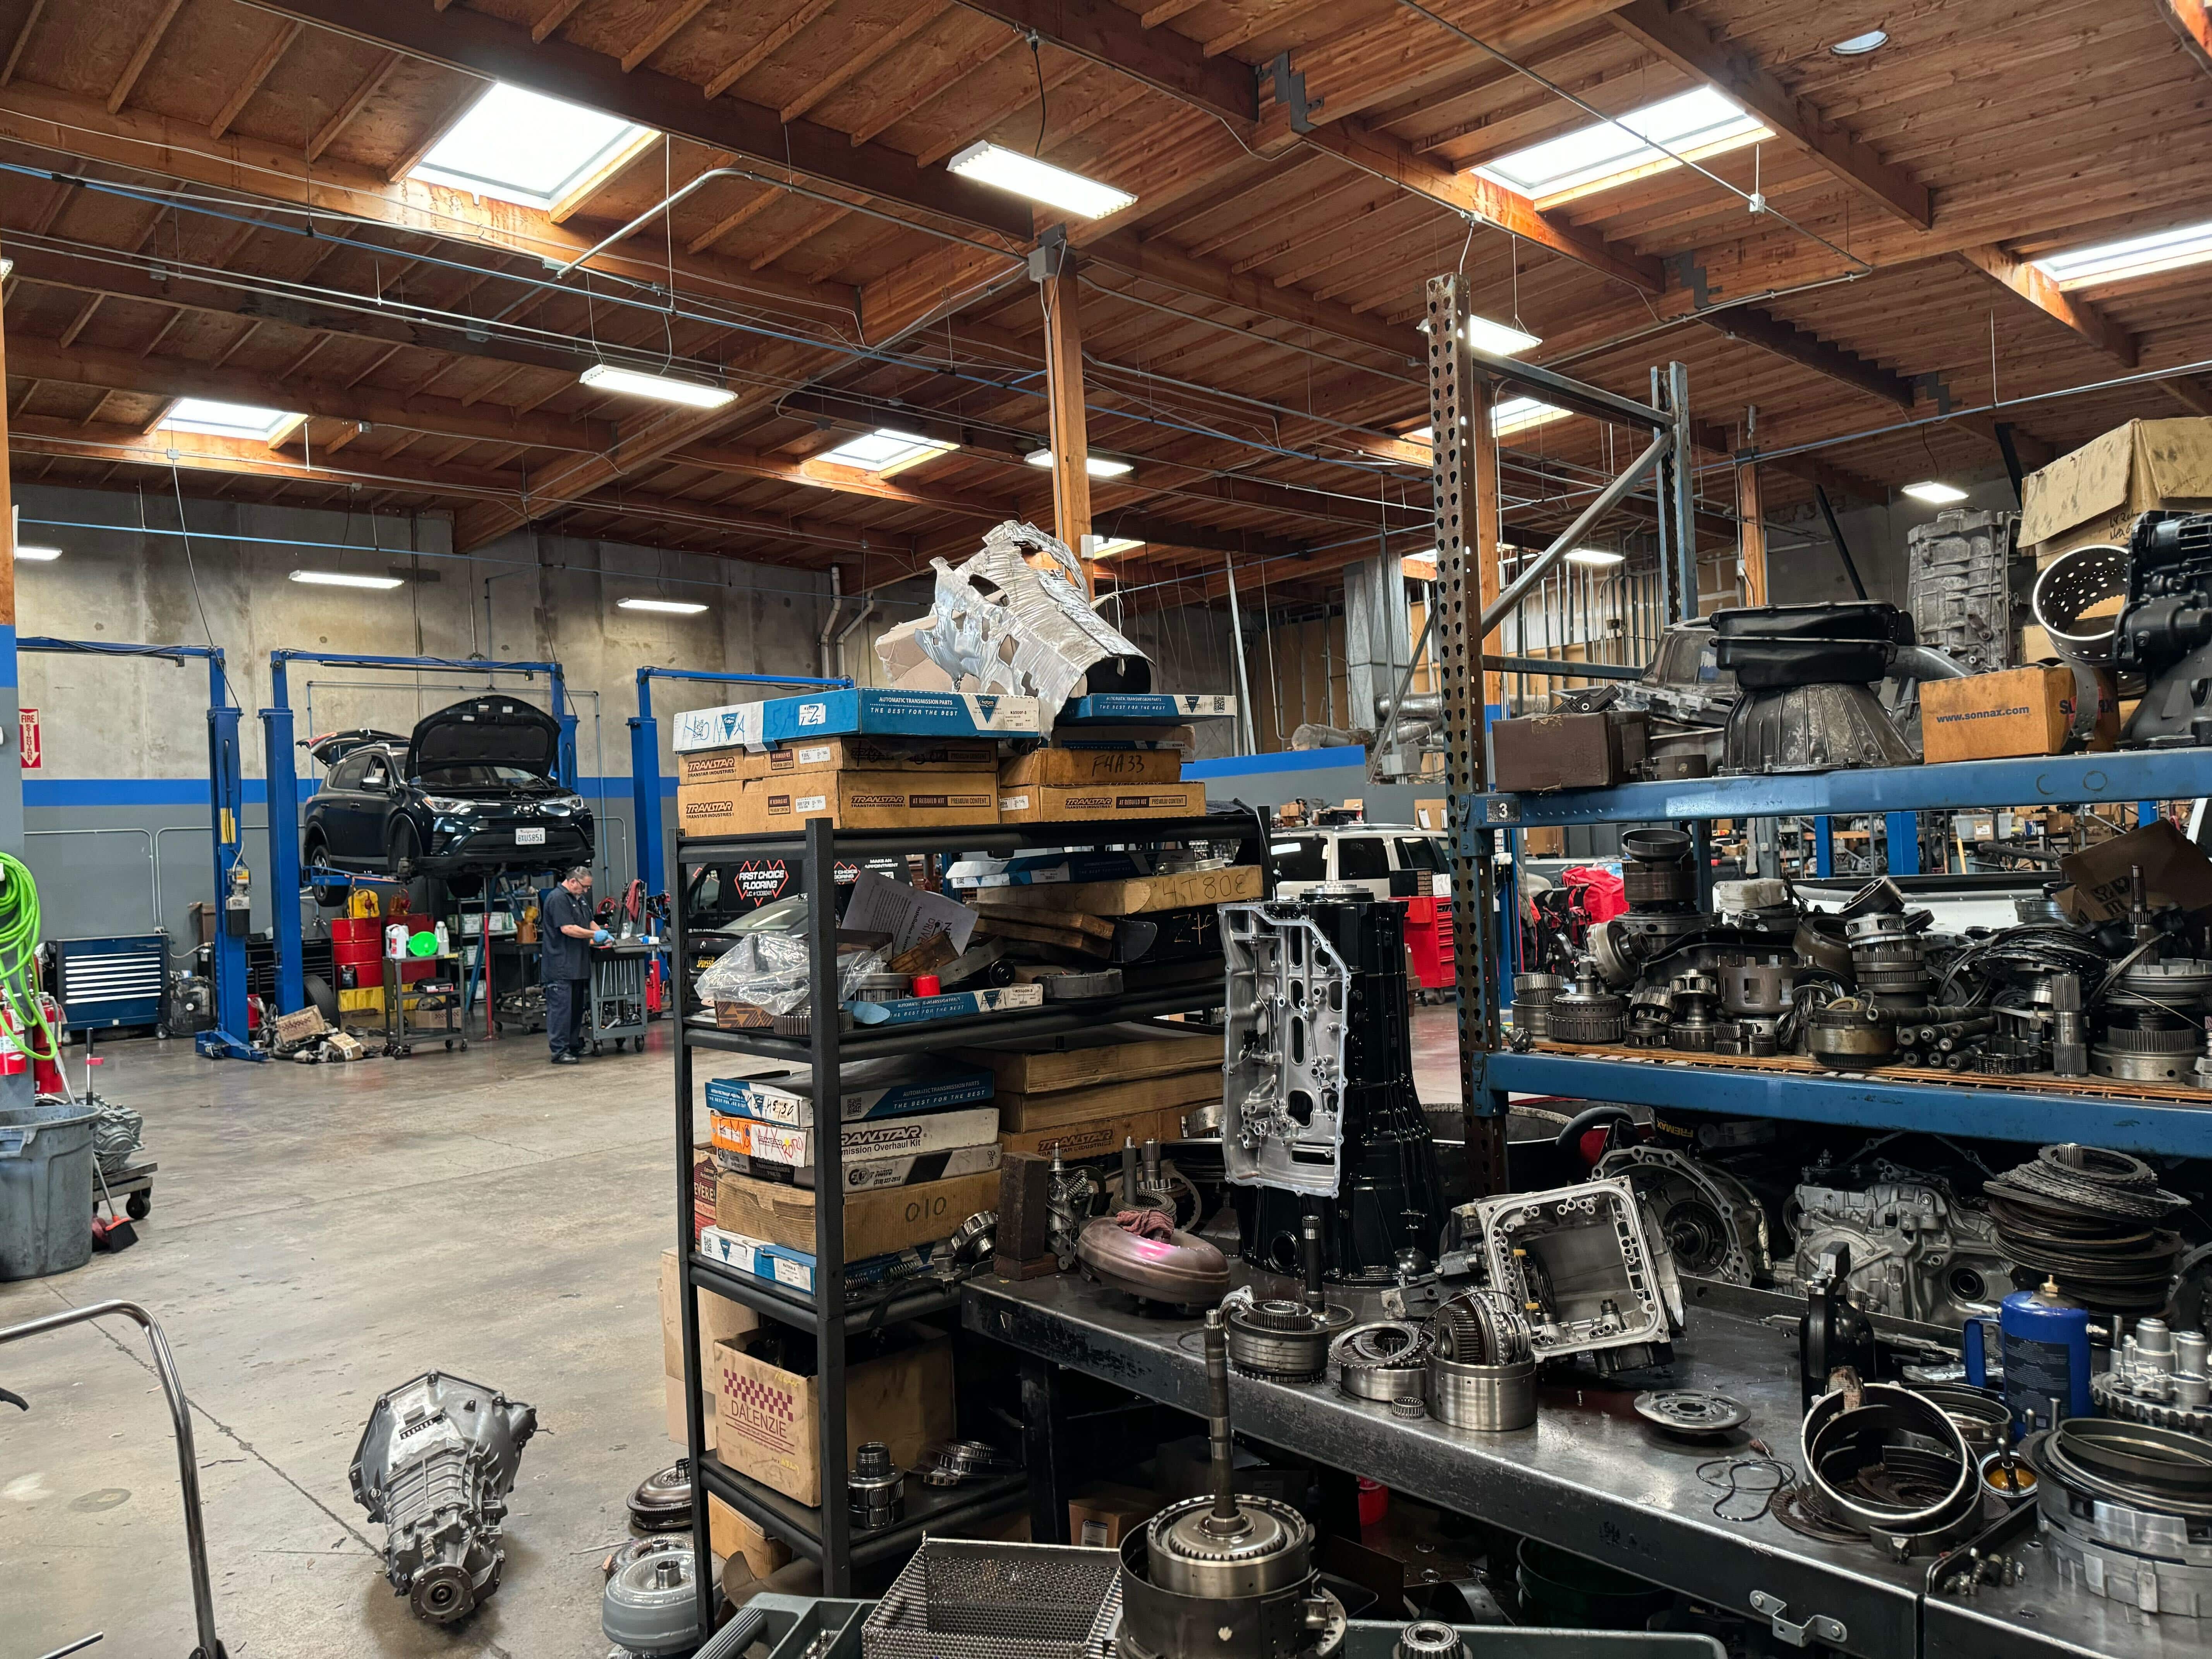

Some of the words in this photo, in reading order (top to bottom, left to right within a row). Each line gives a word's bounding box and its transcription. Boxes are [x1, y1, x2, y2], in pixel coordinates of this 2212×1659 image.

[21, 715, 34, 723] FIRE
[1937, 706, 2030, 723] www.sonnax.com
[687, 756, 735, 773] TRANSTAR
[686, 801, 733, 814] TRANSTAR
[852, 795, 905, 804] TRANSTAR
[1499, 803, 1508, 818] 3
[739, 872, 758, 881] FIRST
[758, 869, 785, 879] CHOICE
[742, 880, 778, 890] FLOORING
[907, 906, 922, 935] Installation
[903, 1087, 931, 1097] AUTOMATIC
[931, 1083, 965, 1093] TRANSMISSION
[842, 1125, 922, 1146] RANSTAR
[1657, 1120, 1694, 1138] FREMAX
[842, 1146, 872, 1156] mission
[874, 1139, 908, 1152] Overhaul
[910, 1139, 921, 1147] Kit
[1037, 1129, 1113, 1152] TRANSTAR
[694, 1182, 715, 1202] EVERE
[731, 1400, 787, 1439] DALENZIE
